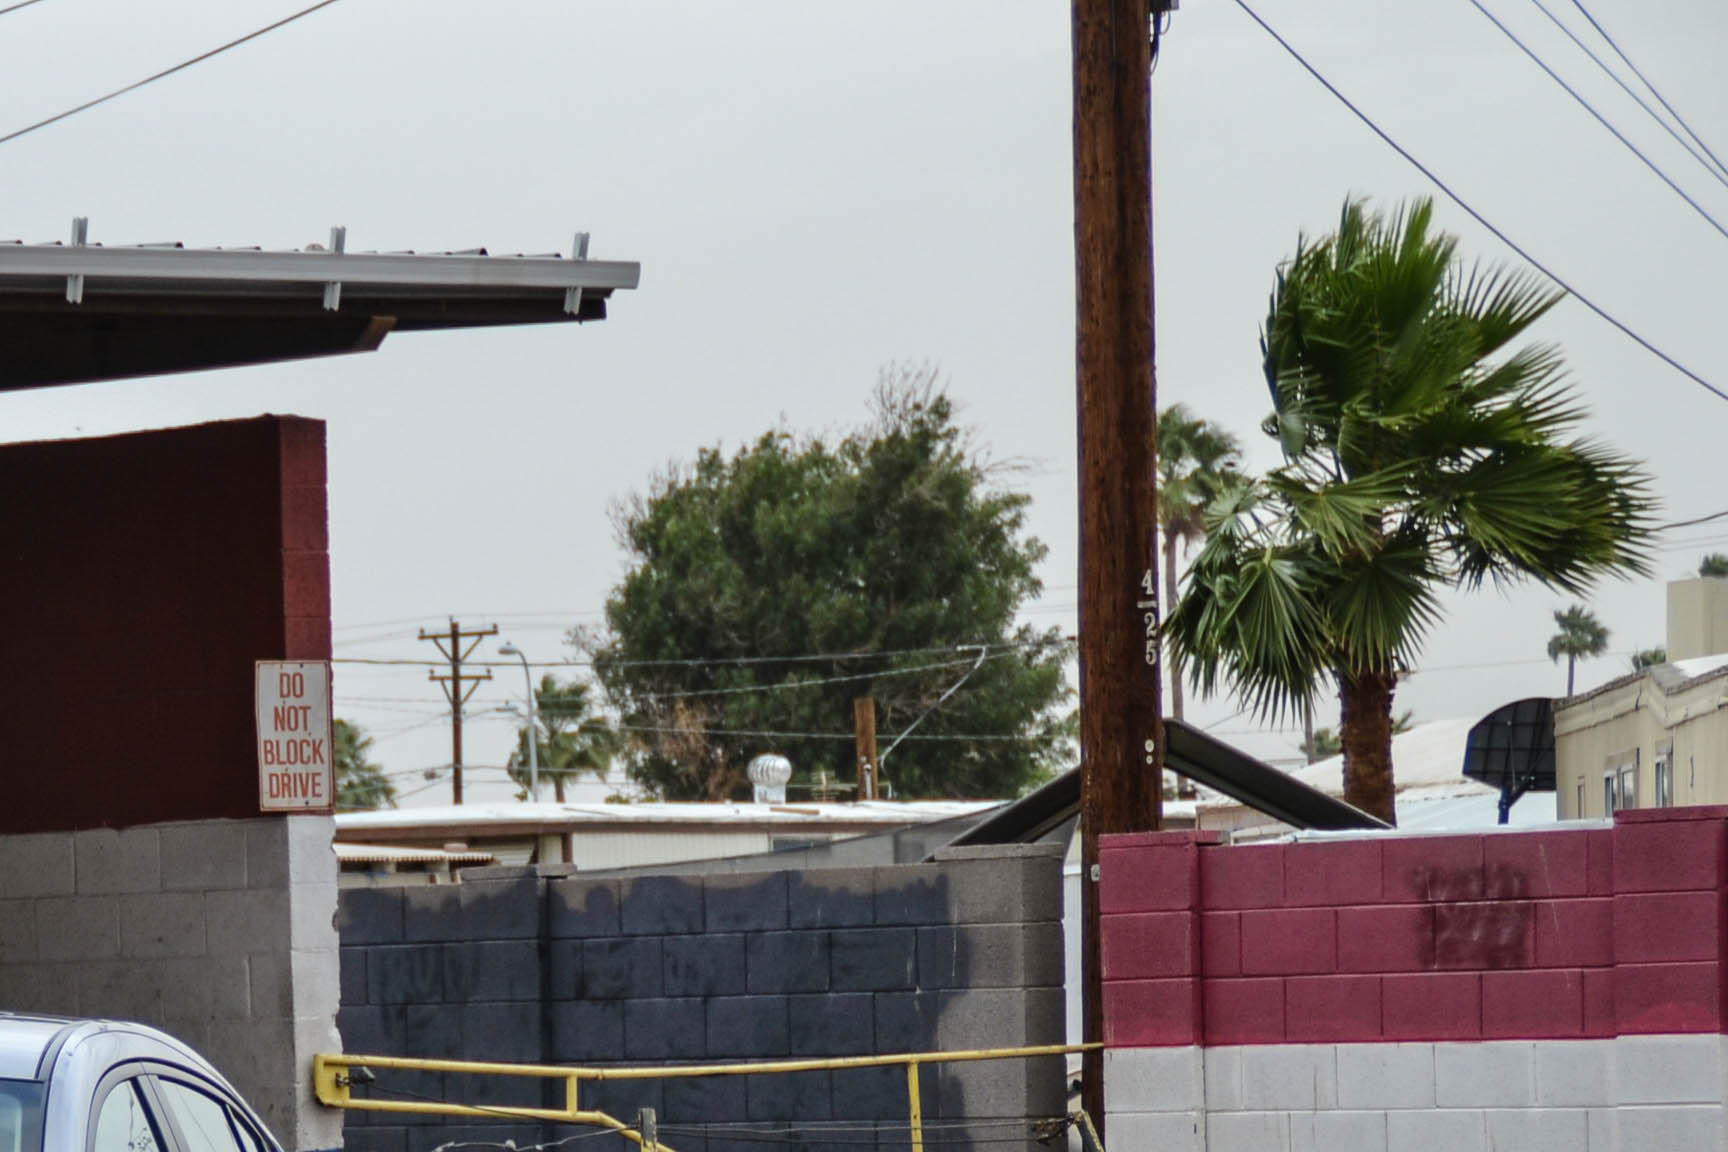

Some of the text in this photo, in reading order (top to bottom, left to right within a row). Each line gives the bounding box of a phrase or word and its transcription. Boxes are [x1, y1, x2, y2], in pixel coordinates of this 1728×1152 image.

[279, 672, 304, 698] DO
[273, 706, 311, 731] NOT
[263, 738, 324, 765] BLOCK
[269, 772, 322, 798] DRIVE
